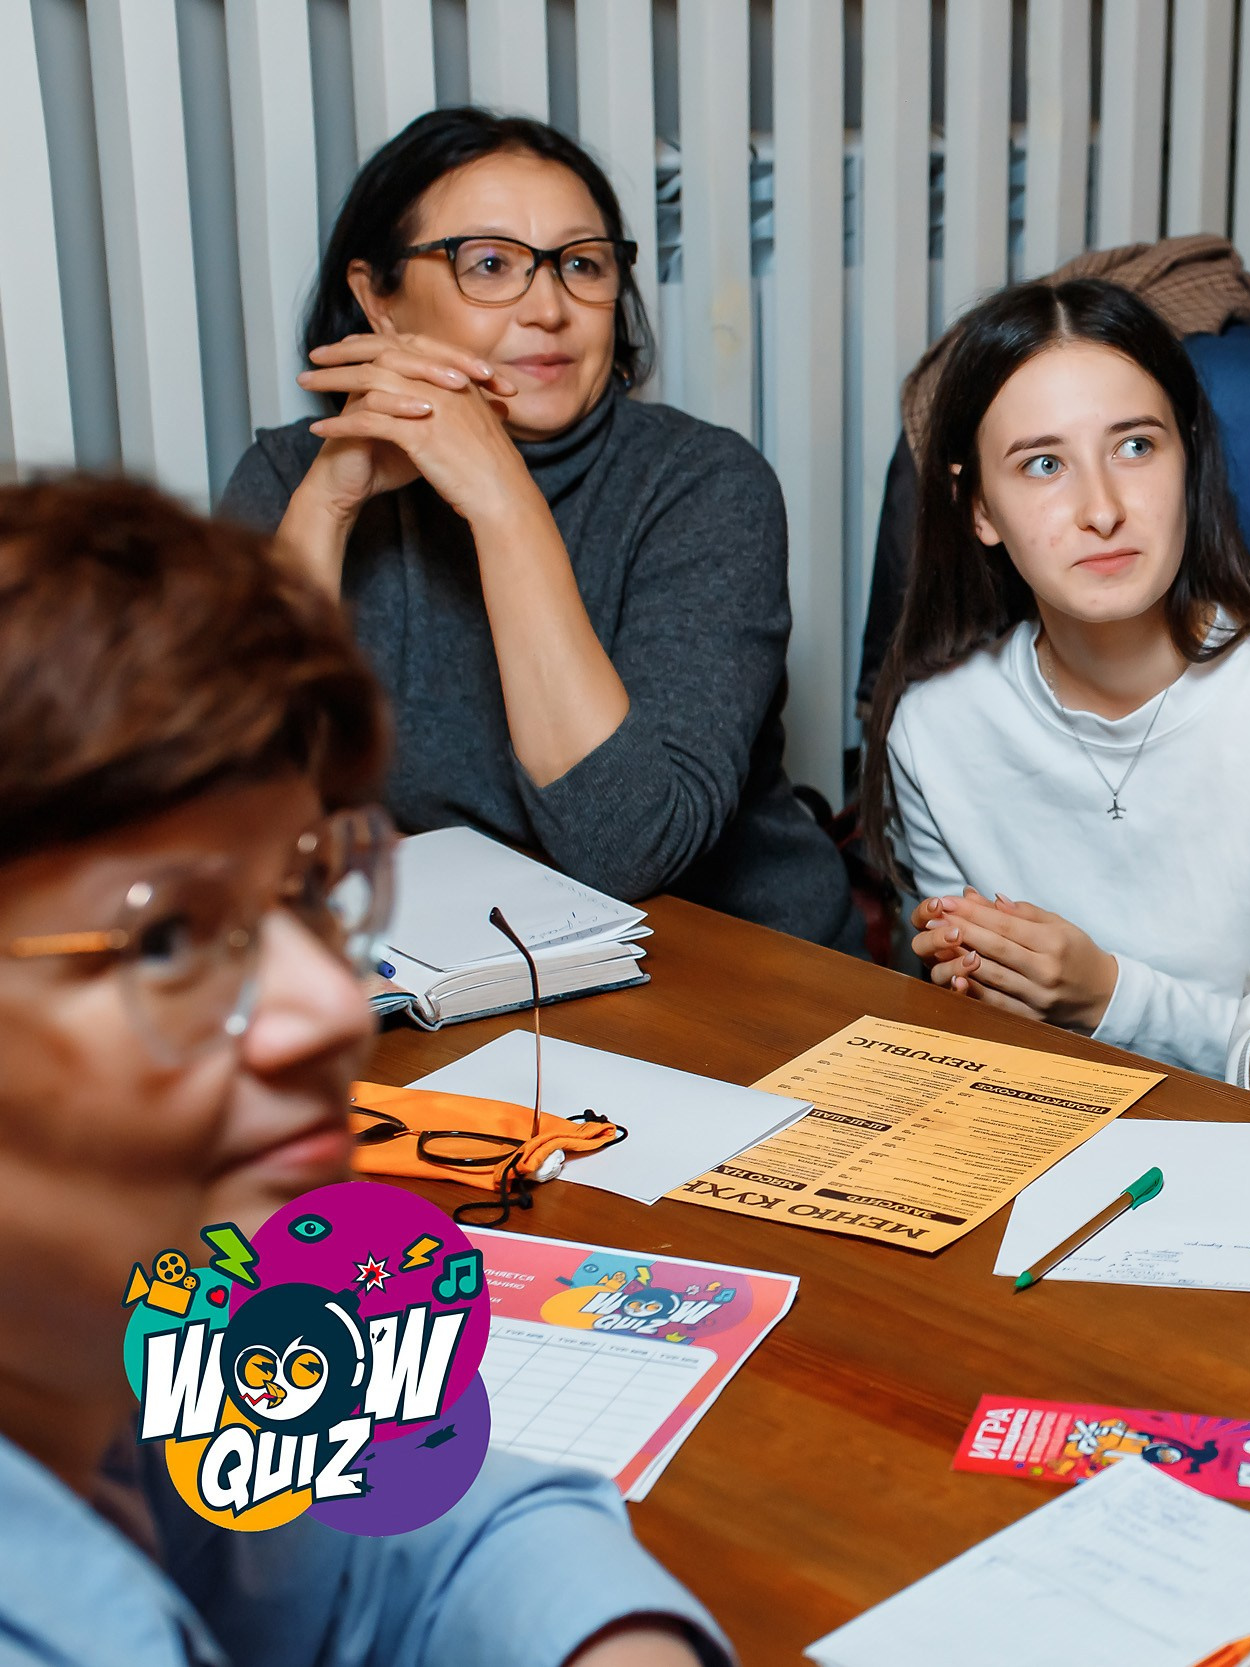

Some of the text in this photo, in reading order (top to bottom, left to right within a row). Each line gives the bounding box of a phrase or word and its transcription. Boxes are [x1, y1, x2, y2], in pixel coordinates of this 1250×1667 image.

[846, 1036, 988, 1072] REPUBLIC
[975, 1083, 1017, 1096] СОУСЕ
[1028, 1095, 1107, 1114] ПРОДУКТЫ
[723, 1167, 749, 1177] НА
[748, 1174, 799, 1189] МЯСО
[846, 1195, 937, 1218] ЗАКУСИТЬ
[787, 1203, 931, 1239] МЕНЮ
[579, 1289, 722, 1324] WOW
[593, 1313, 671, 1335] QUIZ
[967, 1407, 1015, 1460] ИГРА
